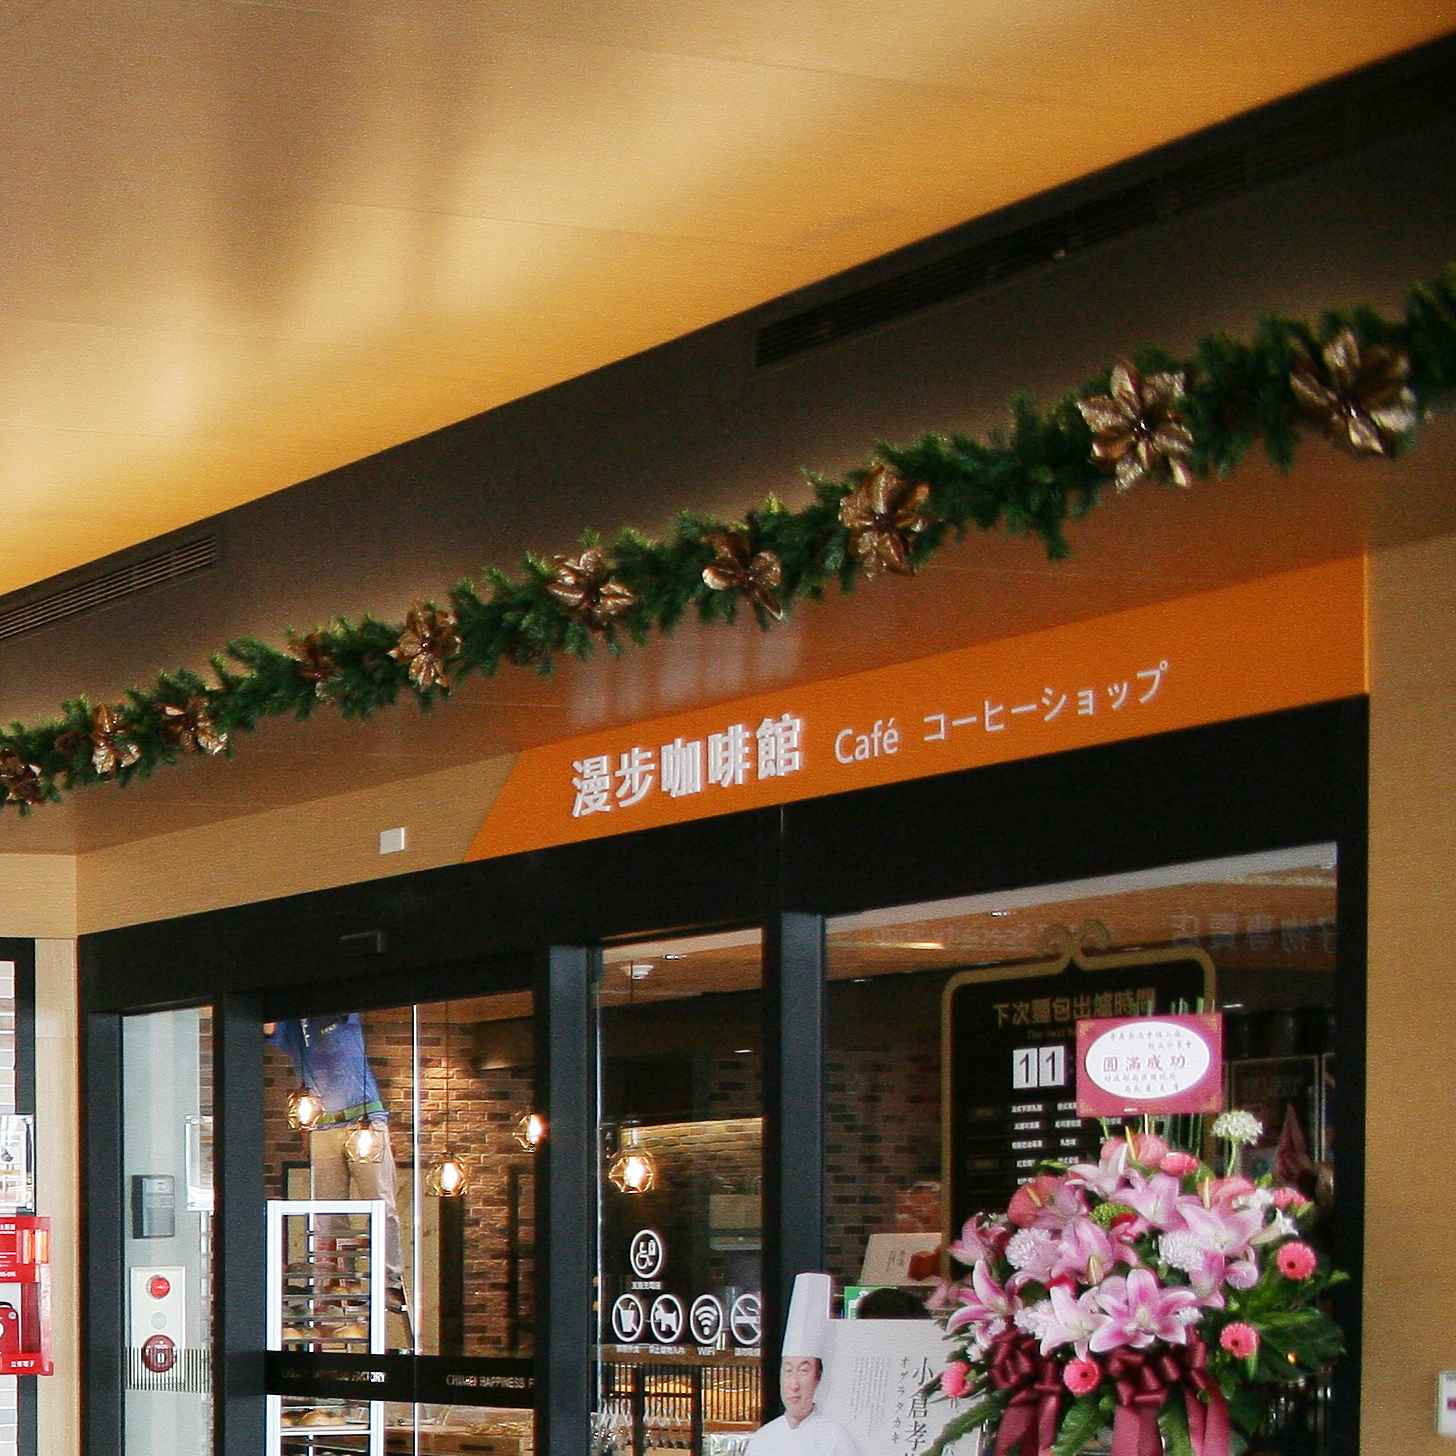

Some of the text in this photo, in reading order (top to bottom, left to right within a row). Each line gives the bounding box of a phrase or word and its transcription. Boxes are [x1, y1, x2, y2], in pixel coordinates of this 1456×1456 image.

[922, 659, 1169, 742] コーヒーショップ
[571, 713, 801, 818] 漫步咖啡館
[833, 719, 900, 766] Café
